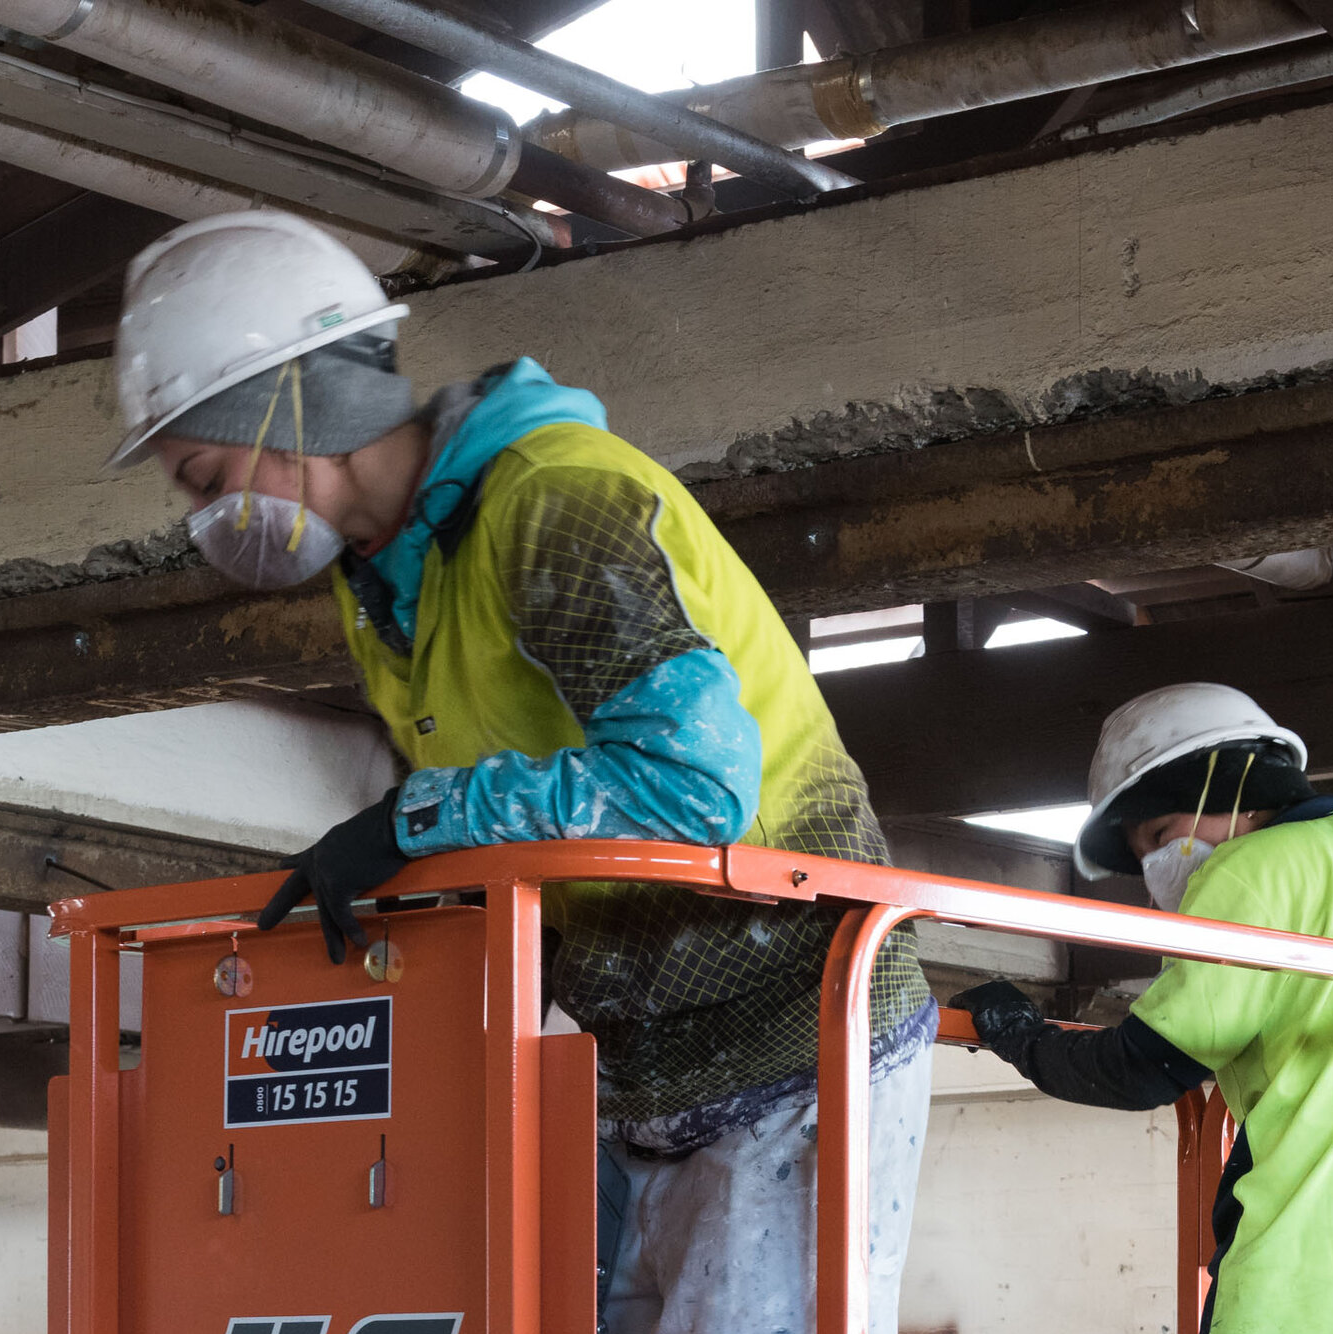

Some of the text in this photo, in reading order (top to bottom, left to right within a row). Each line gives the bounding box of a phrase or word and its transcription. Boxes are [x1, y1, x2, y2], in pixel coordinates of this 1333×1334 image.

[241, 1015, 377, 1063] Hirepool
[255, 1079, 358, 1113] 0800 15 15 15
